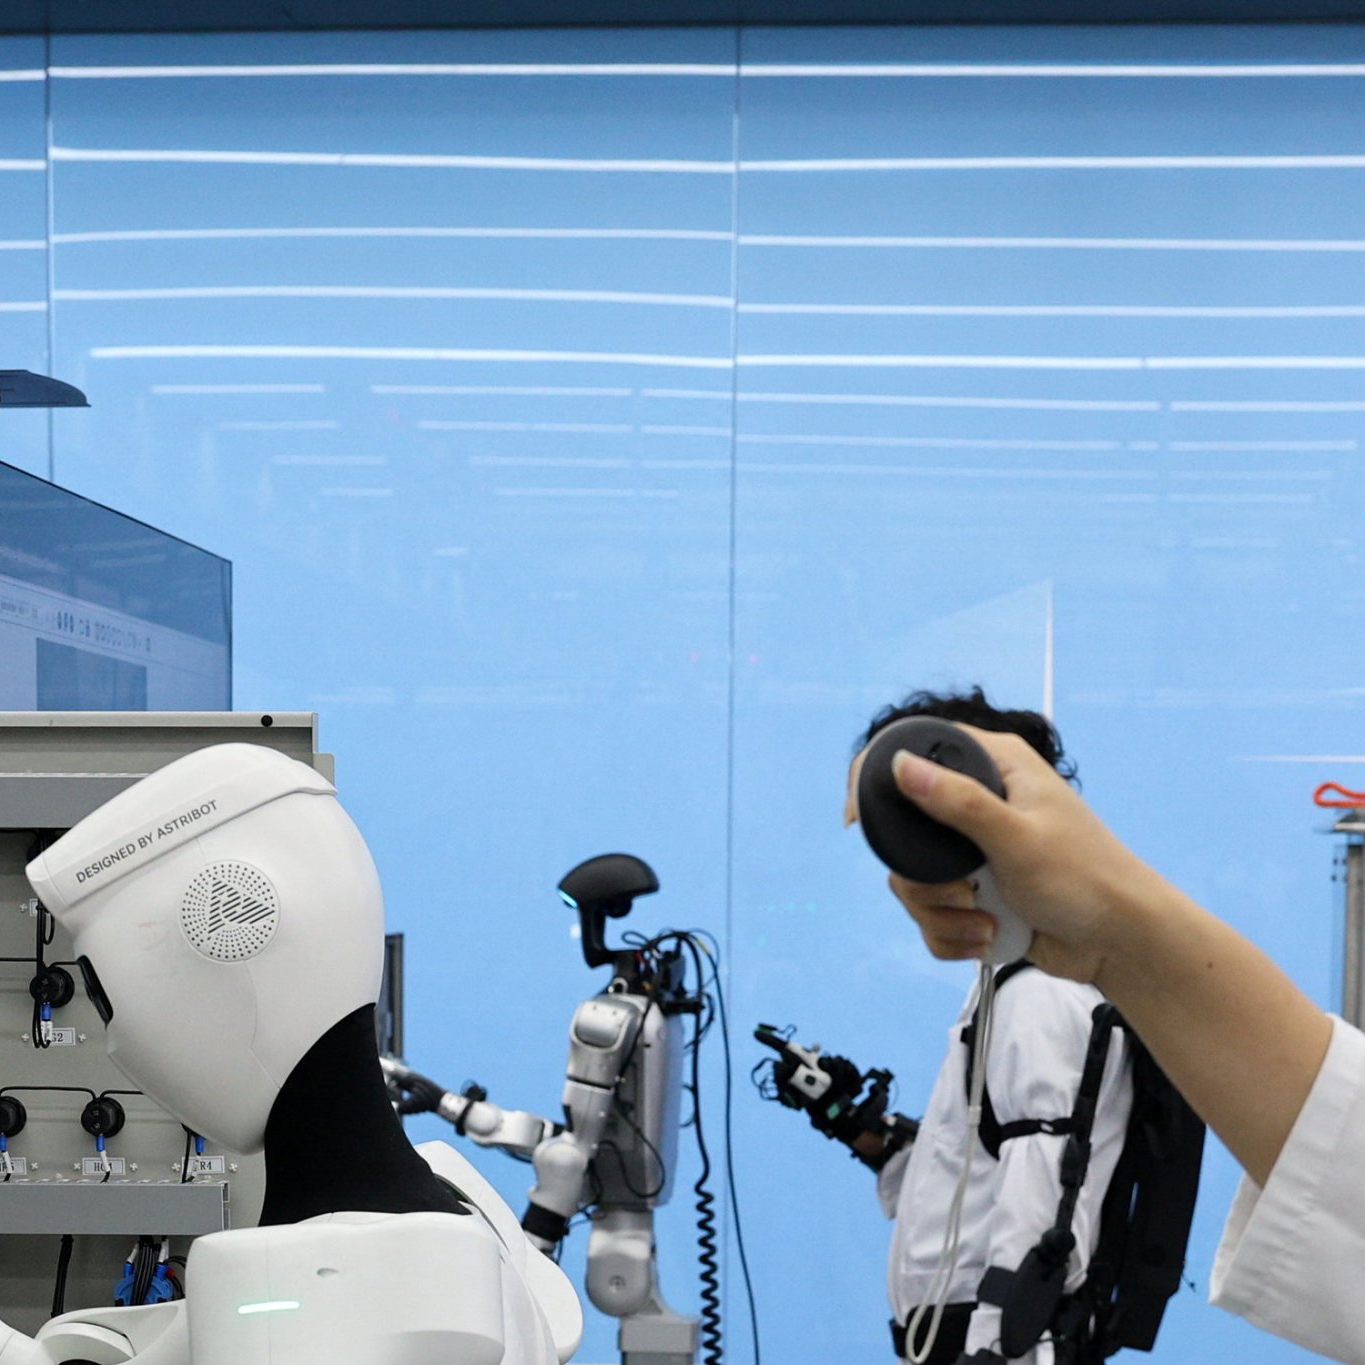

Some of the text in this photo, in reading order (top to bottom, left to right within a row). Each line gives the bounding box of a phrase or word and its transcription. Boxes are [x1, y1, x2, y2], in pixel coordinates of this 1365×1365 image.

[76, 799, 219, 884] DESIGNED BY ASTRIBOT
